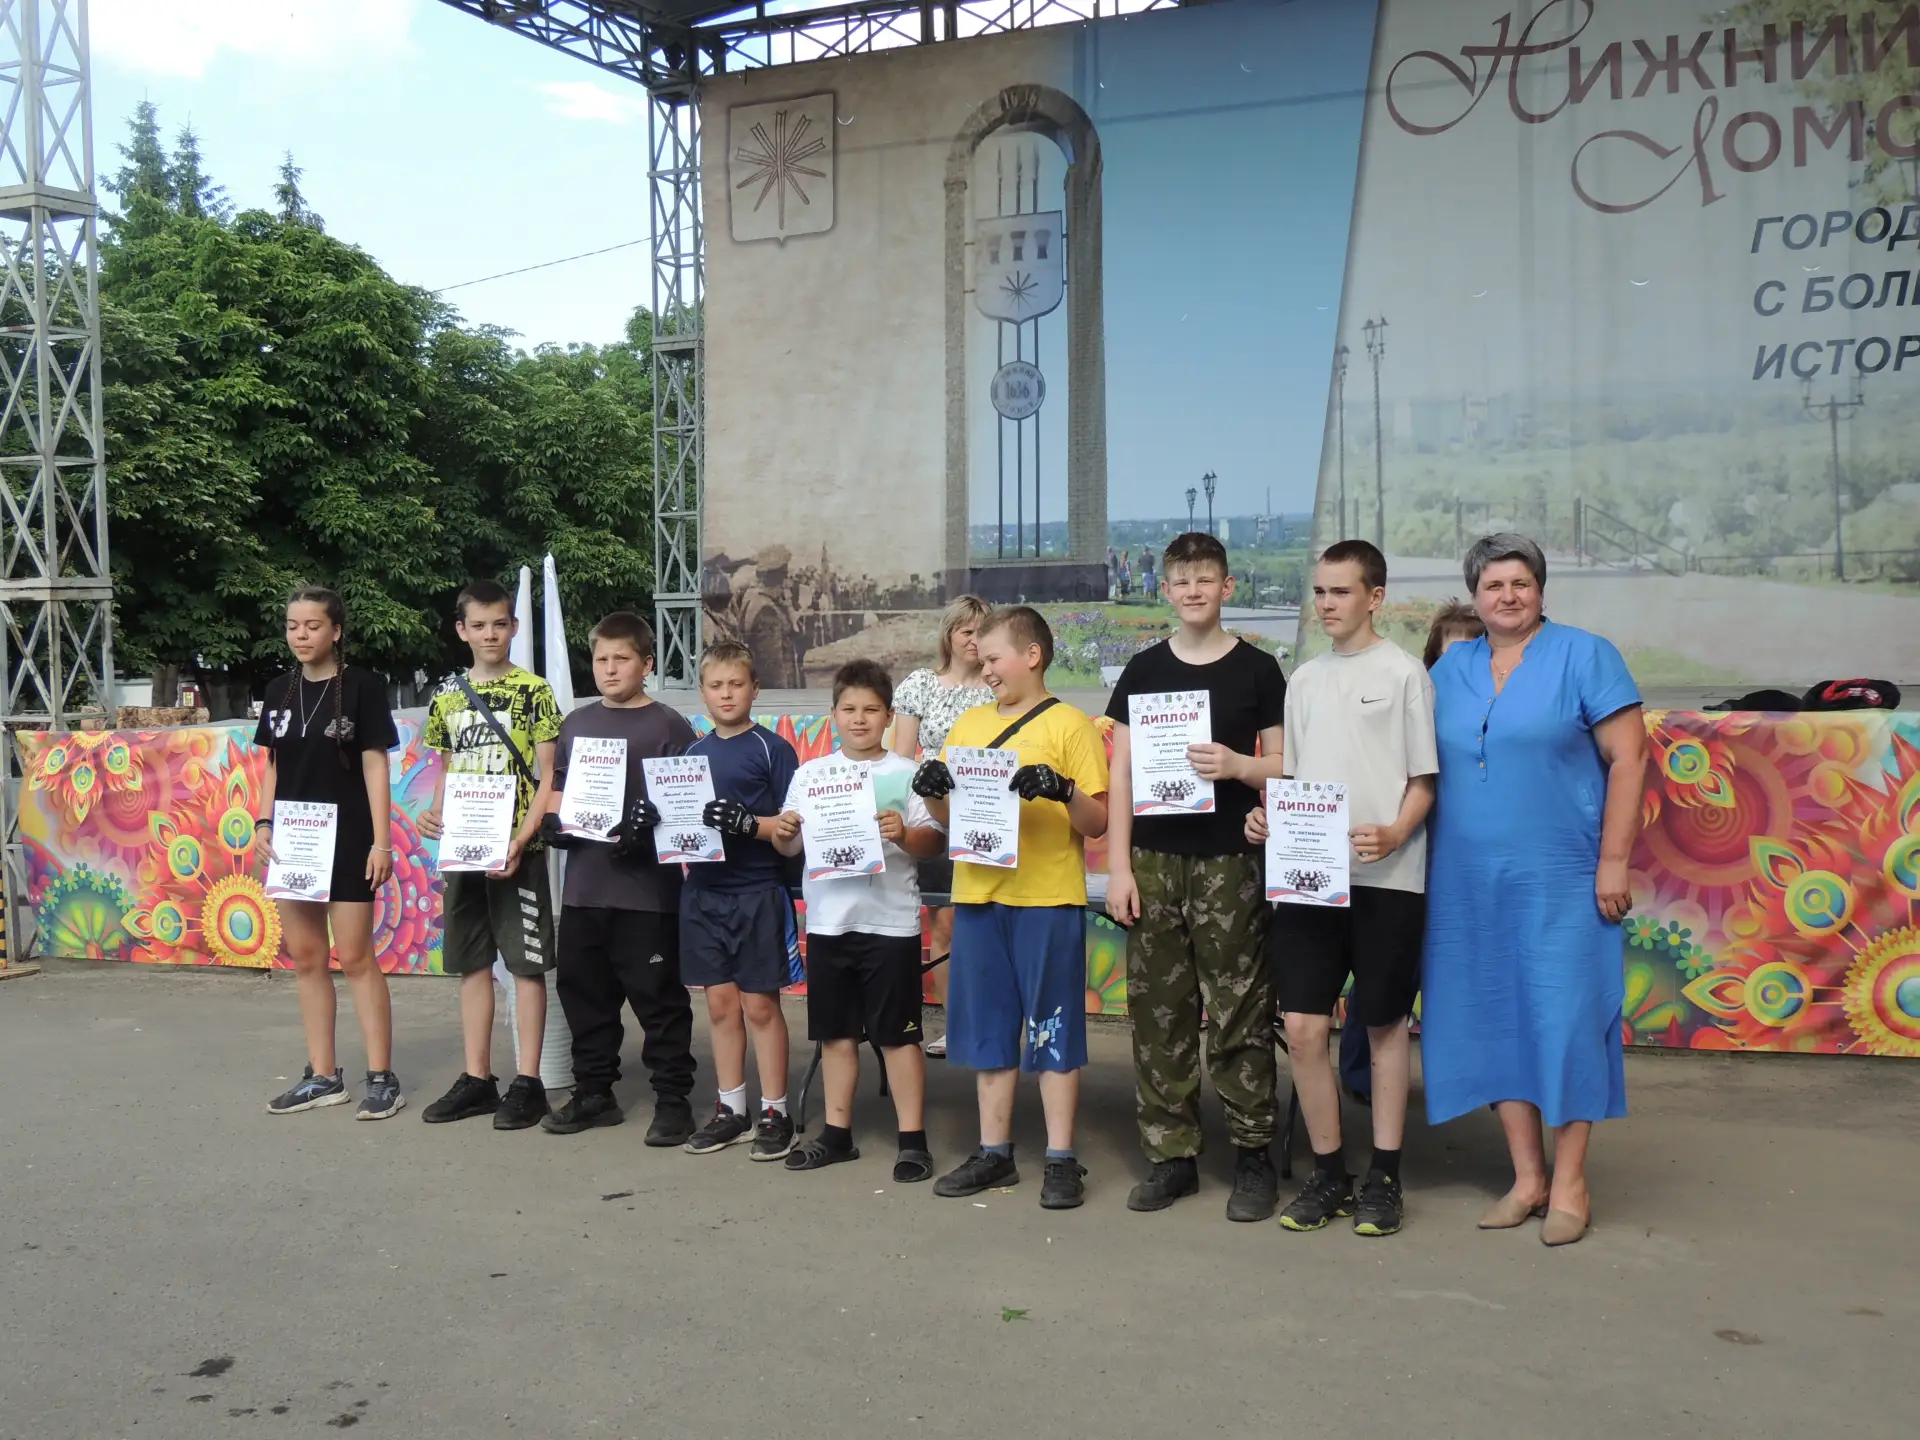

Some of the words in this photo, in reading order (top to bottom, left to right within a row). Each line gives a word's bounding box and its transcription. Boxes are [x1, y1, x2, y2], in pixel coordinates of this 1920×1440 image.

[1750, 205, 1920, 254] ГОРОД
[1753, 280, 1787, 317] С
[1801, 269, 1920, 314] БОЛ
[1752, 334, 1920, 381] ИСТОР
[1140, 711, 1199, 726] ДИПЛОМ
[579, 754, 621, 765] ДИПЛОМ
[956, 765, 1009, 779] ДИПЛОМ
[655, 774, 704, 786] ДИПЛОМ
[453, 790, 506, 800] ДИПЛОМ
[807, 782, 863, 798] ДИПЛОМ
[1276, 800, 1337, 814] ДИПЛОМ
[282, 817, 328, 828] ДИПЛОМ
